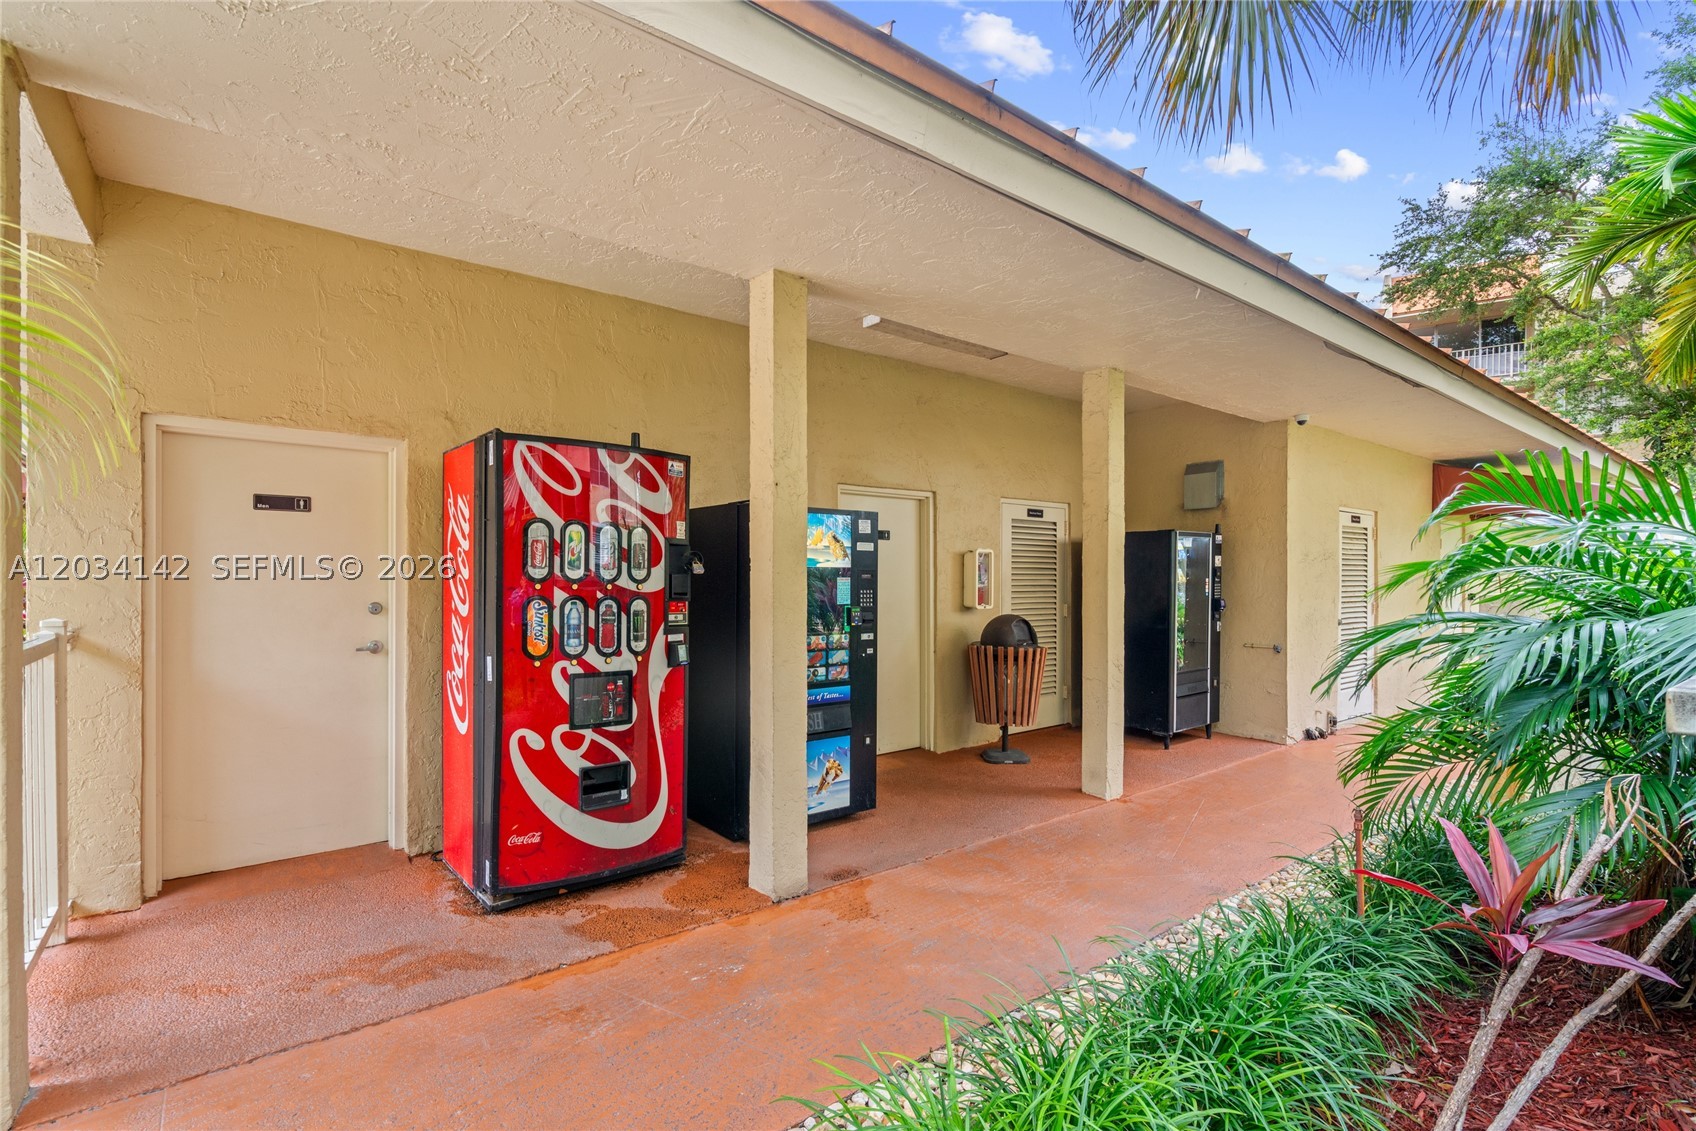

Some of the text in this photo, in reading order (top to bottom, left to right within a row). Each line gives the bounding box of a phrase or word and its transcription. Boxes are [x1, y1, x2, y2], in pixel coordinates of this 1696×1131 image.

[447, 482, 470, 735] Coca-Cola
[532, 600, 548, 647] Sunkist
[816, 692, 824, 701] of
[508, 831, 543, 846] Coca-Cola
